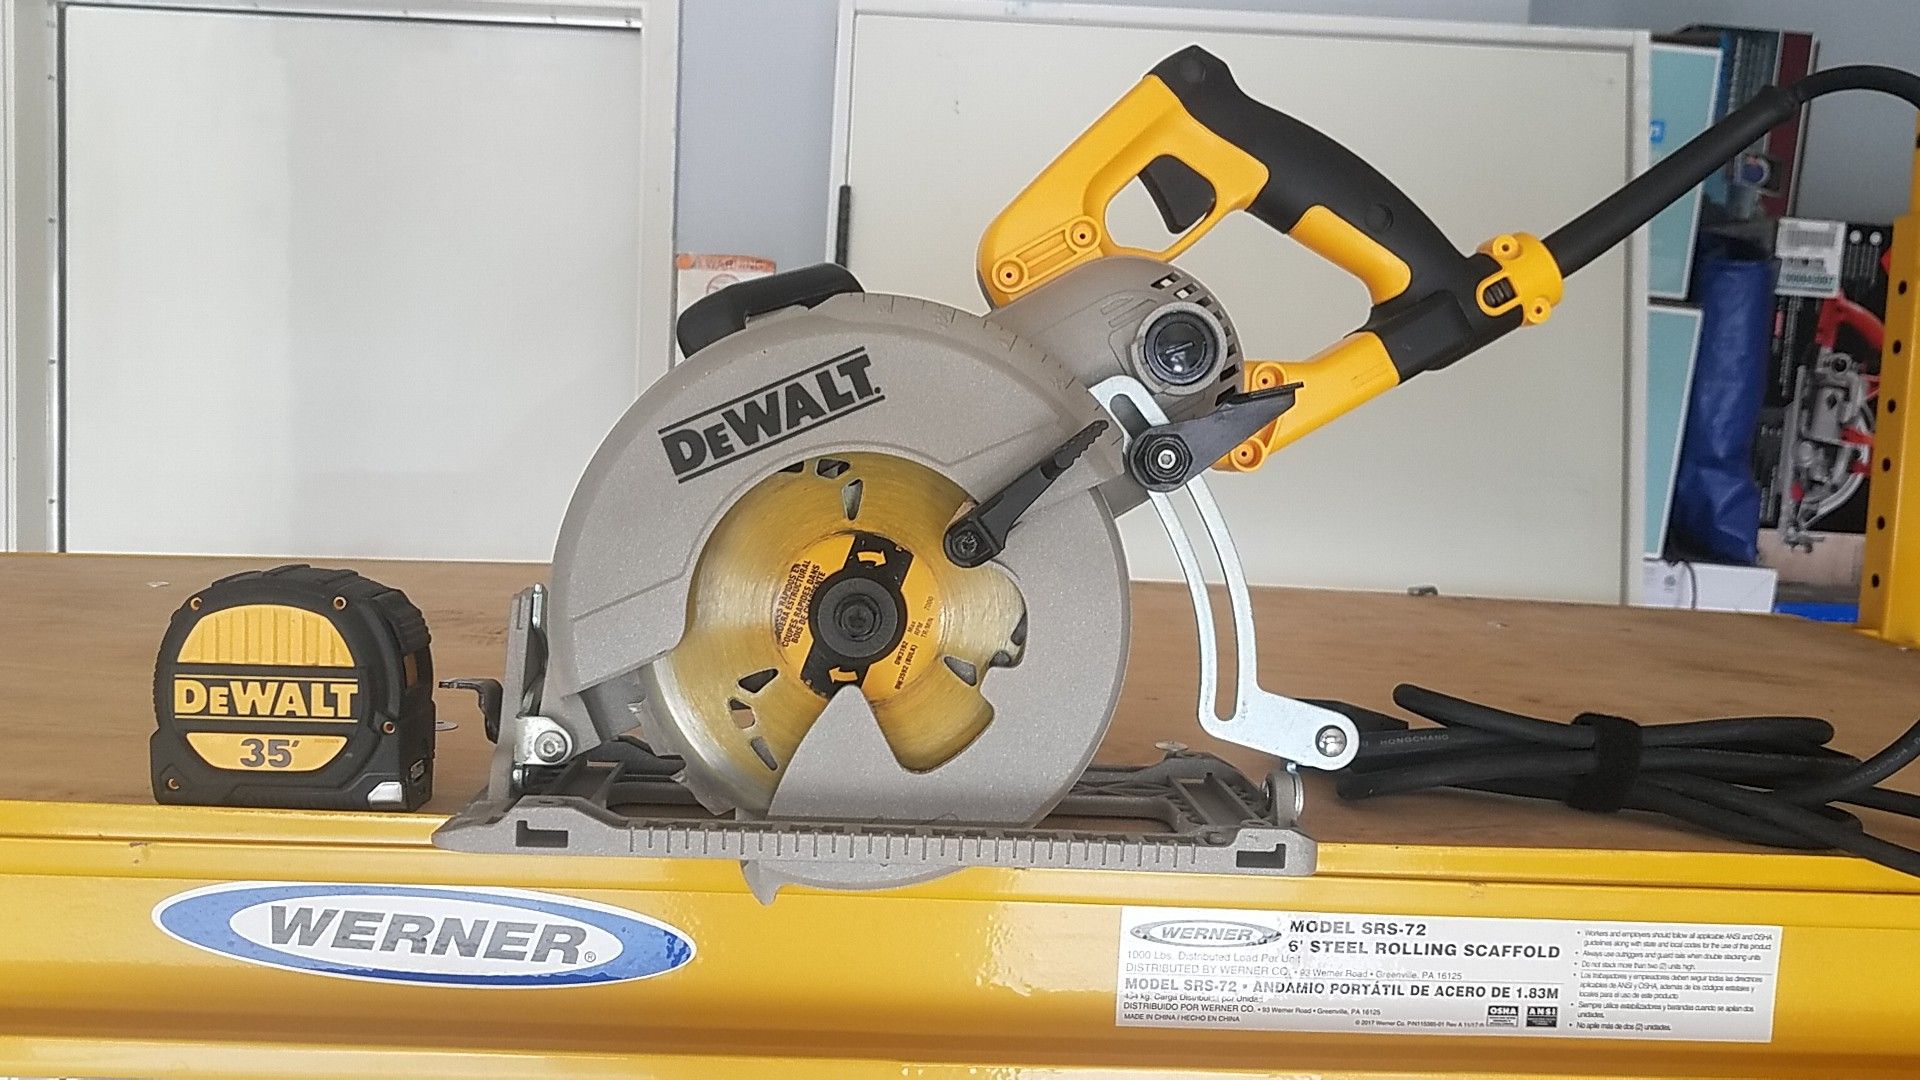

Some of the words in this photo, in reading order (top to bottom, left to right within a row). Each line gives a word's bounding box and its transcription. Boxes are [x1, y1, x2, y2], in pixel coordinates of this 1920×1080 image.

[782, 618, 798, 647] COUPES
[794, 585, 811, 617] RAPIDES
[807, 564, 820, 585] DANS
[791, 626, 804, 643] BOIS
[174, 678, 359, 718] DEWALT
[1380, 734, 1449, 746] HONGCHANG
[240, 738, 300, 768] 35'
[1162, 926, 1253, 941] WERNER
[1290, 919, 1355, 934] MODEL
[1361, 921, 1426, 936] SRS-72
[1234, 952, 1257, 962] Load
[1288, 939, 1303, 953] 6'
[1310, 940, 1368, 954] STEEL
[1375, 941, 1457, 956] ROLLING
[1464, 943, 1560, 958] SCAFFOLD
[1126, 963, 1199, 973] DISTRIBUTED
[1203, 965, 1216, 974] BY
[1221, 966, 1269, 976] WERNER
[1313, 969, 1342, 977] Werner
[1345, 969, 1367, 978] Road
[1421, 971, 1434, 979] PA
[1437, 972, 1462, 980] 16125
[1125, 977, 1179, 991] MODEL
[1184, 979, 1237, 992] SRS-72
[1253, 981, 1324, 994] ANDAMIO
[1330, 980, 1405, 996] PORTÁTIL
[1410, 984, 1430, 996] DE
[1434, 985, 1486, 997] ACERO
[1491, 986, 1511, 998] DE
[1516, 987, 1559, 999] 1.83M
[1123, 1002, 1178, 1011] DISTRIBUIDO
[1181, 1003, 1199, 1011] POR
[1201, 1003, 1239, 1012] WERNER
[1489, 1006, 1516, 1015] OSHA
[1529, 1007, 1556, 1016] ANSI
[1124, 1013, 1144, 1021] MADE
[1181, 1014, 1206, 1022] HECHO
